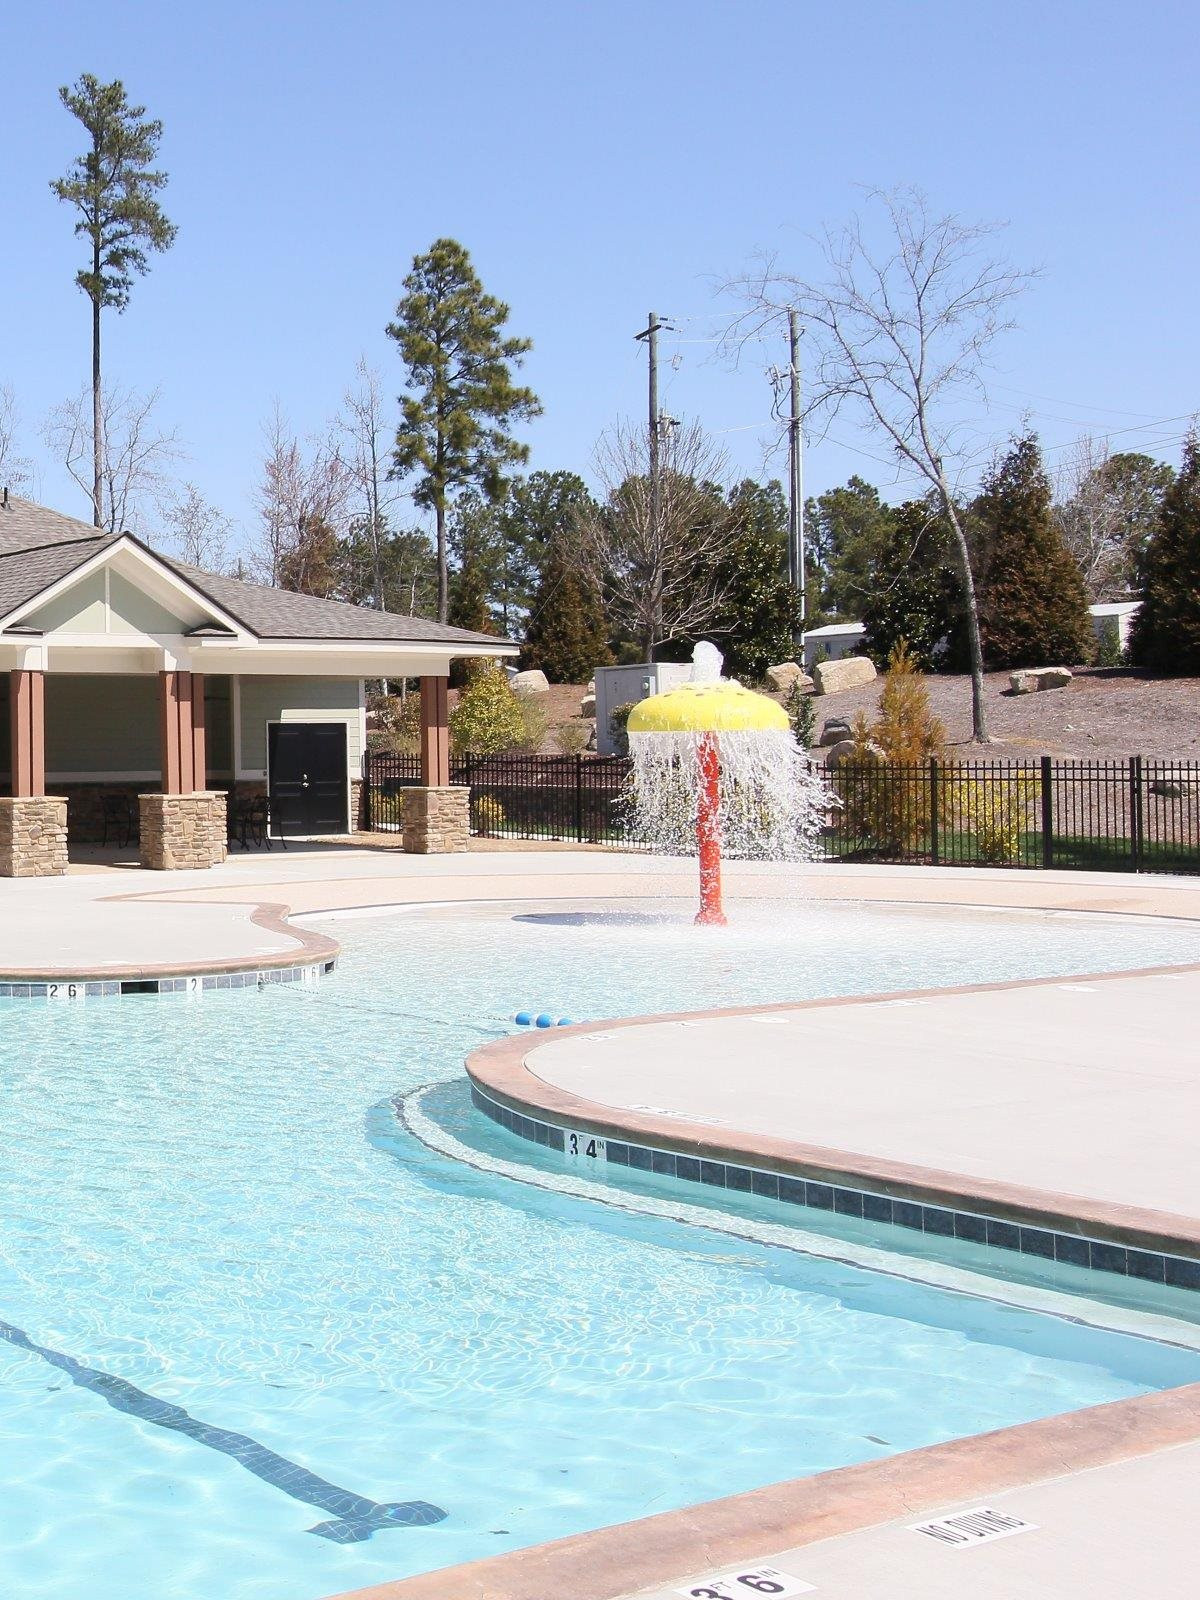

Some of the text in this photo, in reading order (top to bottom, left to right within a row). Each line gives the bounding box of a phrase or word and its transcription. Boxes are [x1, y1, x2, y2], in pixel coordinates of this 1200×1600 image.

[50, 984, 58, 997] 2
[68, 984, 76, 997] 6
[570, 1133, 578, 1155] 3
[586, 1140, 597, 1158] 4
[915, 1510, 1025, 1545] NO DIVING
[736, 1574, 785, 1593] 6
